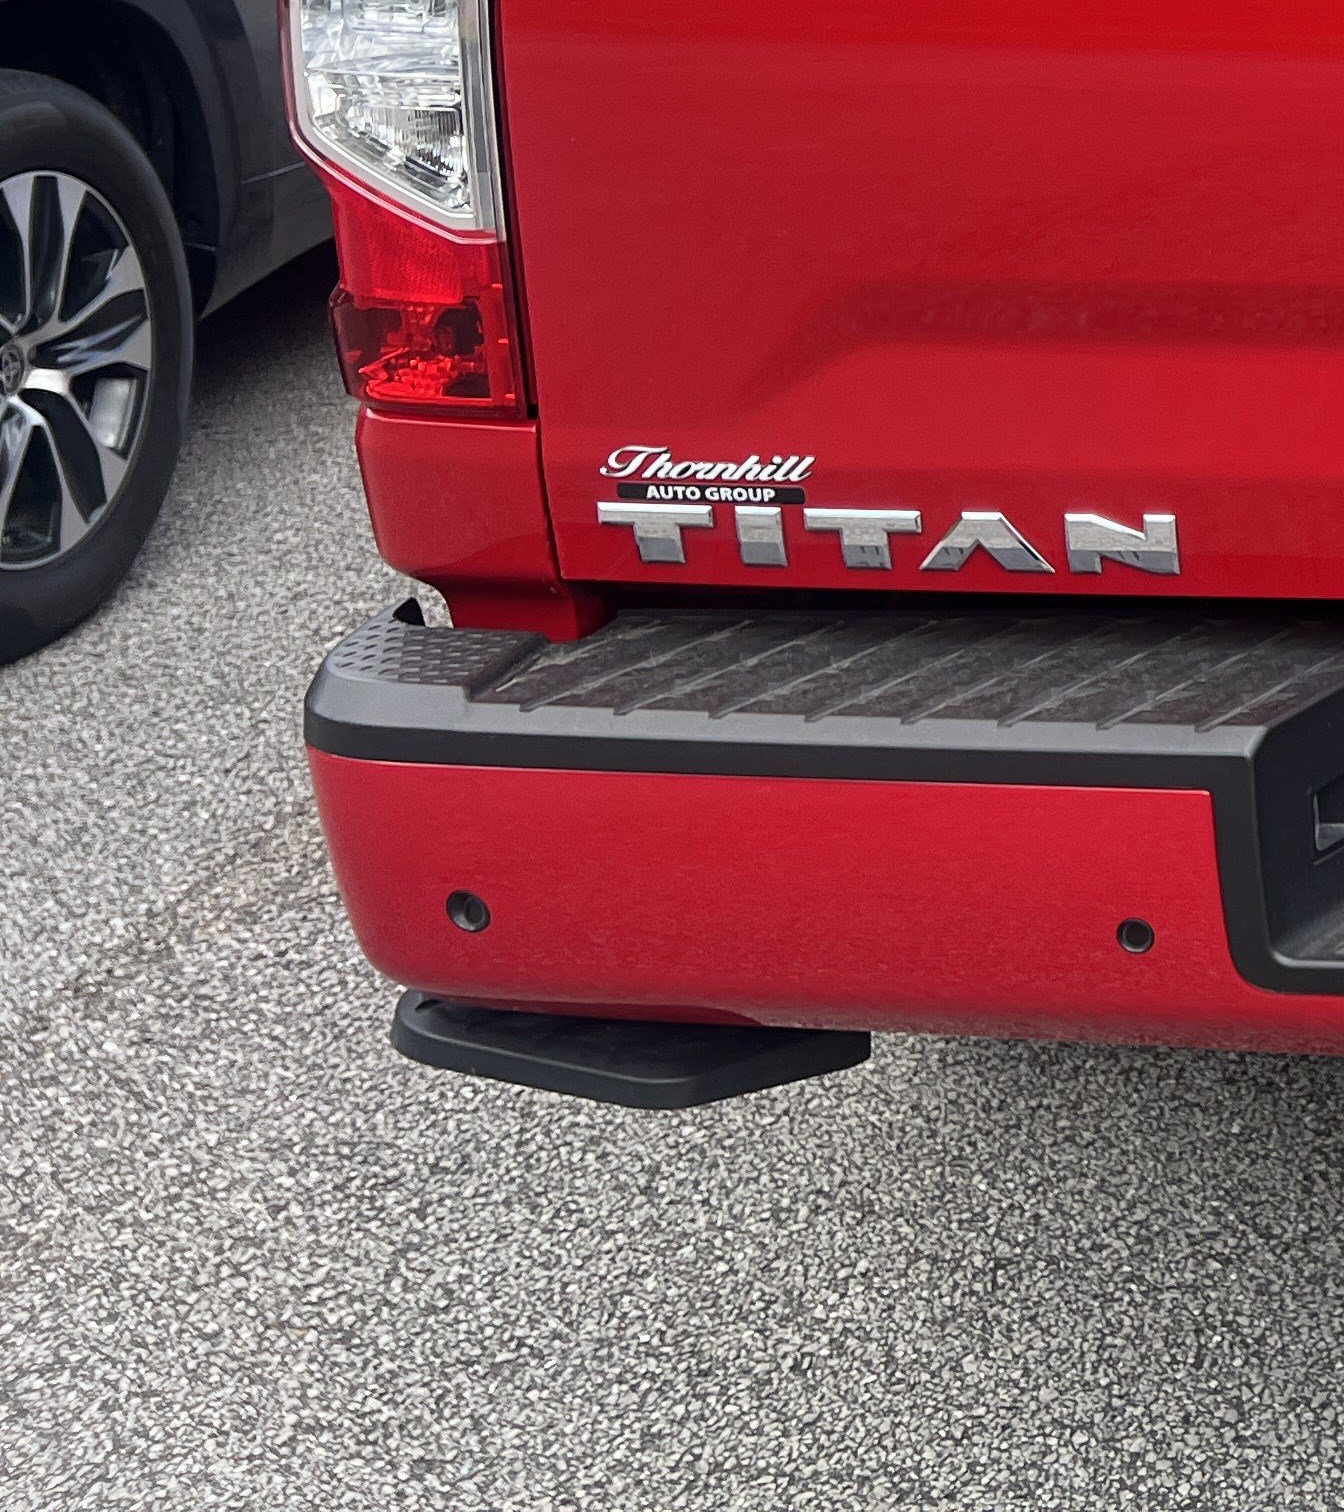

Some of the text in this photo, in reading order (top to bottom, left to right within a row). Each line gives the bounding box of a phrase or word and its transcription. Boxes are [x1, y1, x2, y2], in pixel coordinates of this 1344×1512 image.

[599, 445, 816, 482] Thornhill
[646, 485, 776, 502] AUTO GROUP
[597, 502, 1181, 575] TITAN
